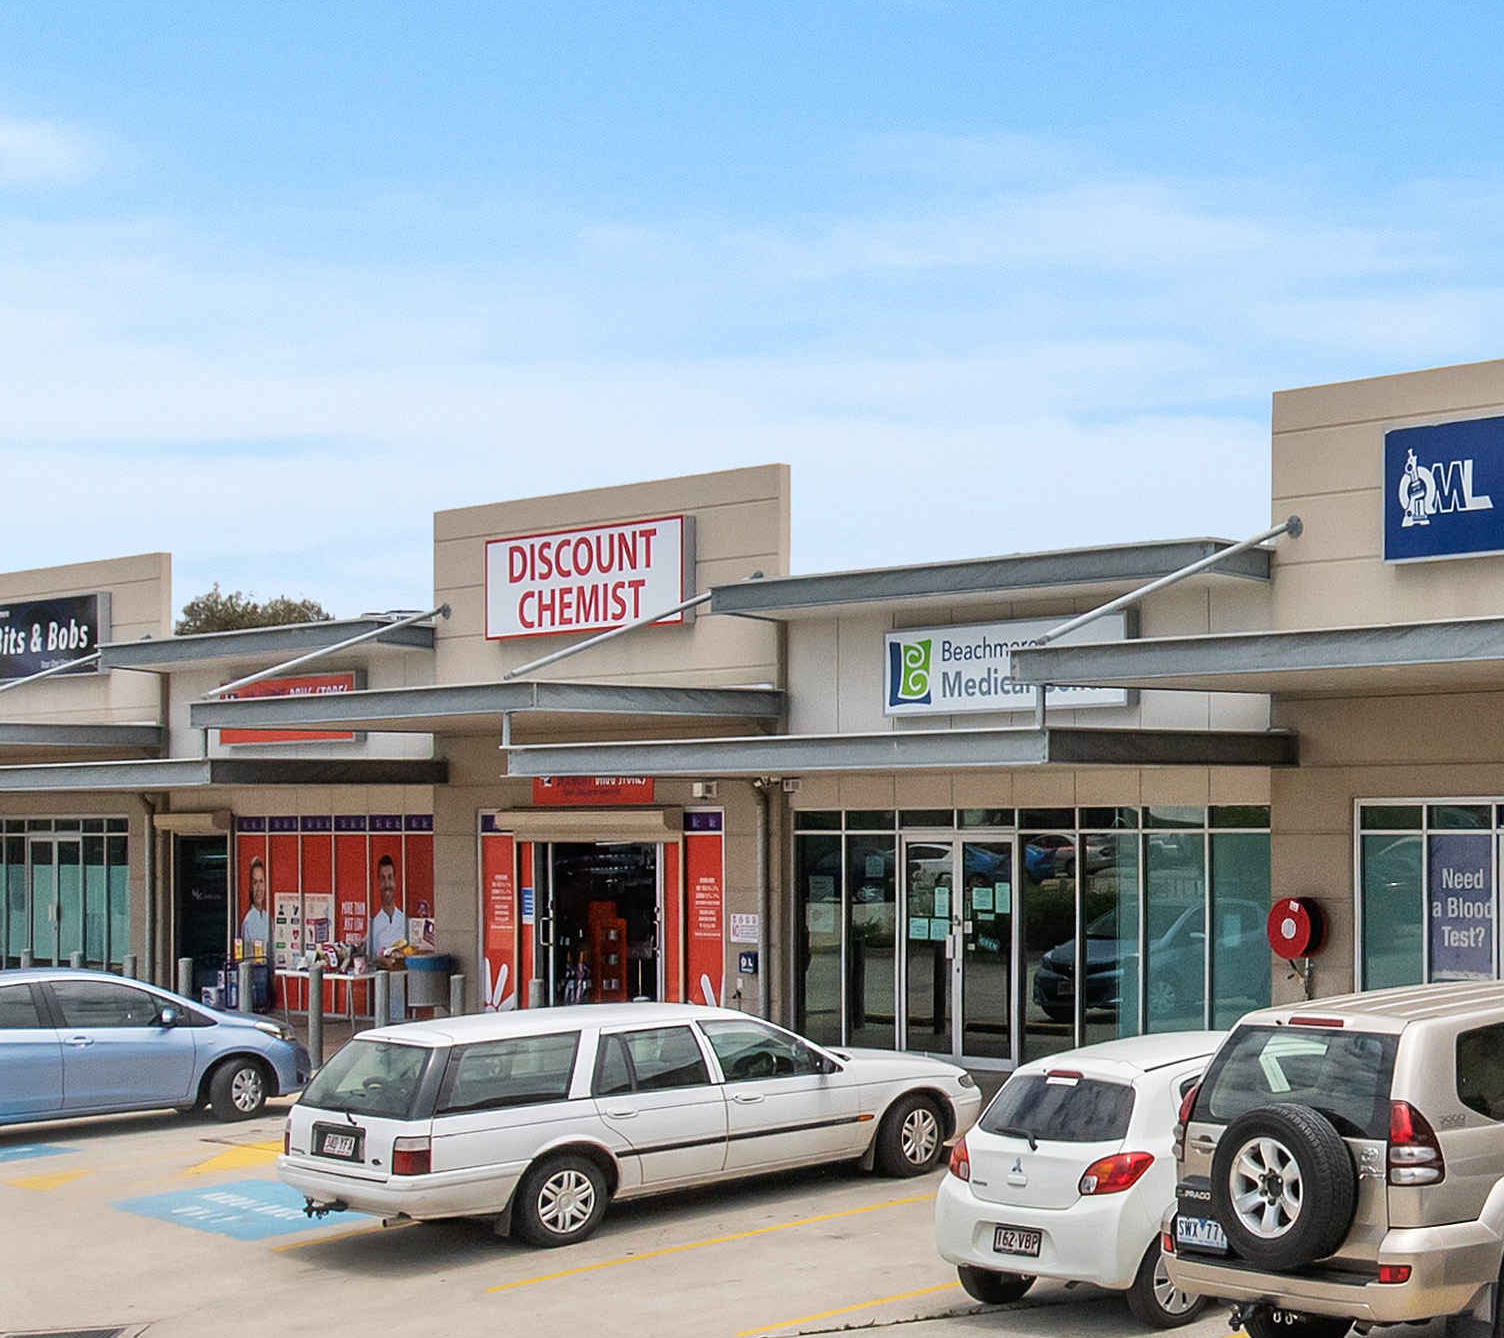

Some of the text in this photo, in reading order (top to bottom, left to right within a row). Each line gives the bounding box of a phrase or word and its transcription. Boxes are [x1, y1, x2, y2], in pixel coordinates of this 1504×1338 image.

[1399, 449, 1494, 527] QML
[508, 528, 657, 584] DISCOUNT
[518, 579, 646, 630] CHEMIST
[30, 622, 44, 653] &
[47, 618, 88, 652] Bobs
[1442, 868, 1483, 890] Need
[1432, 900, 1442, 918] a
[1441, 926, 1486, 949] Test?
[1178, 1219, 1199, 1239] SWX
[1206, 1222, 1226, 1243] 77
